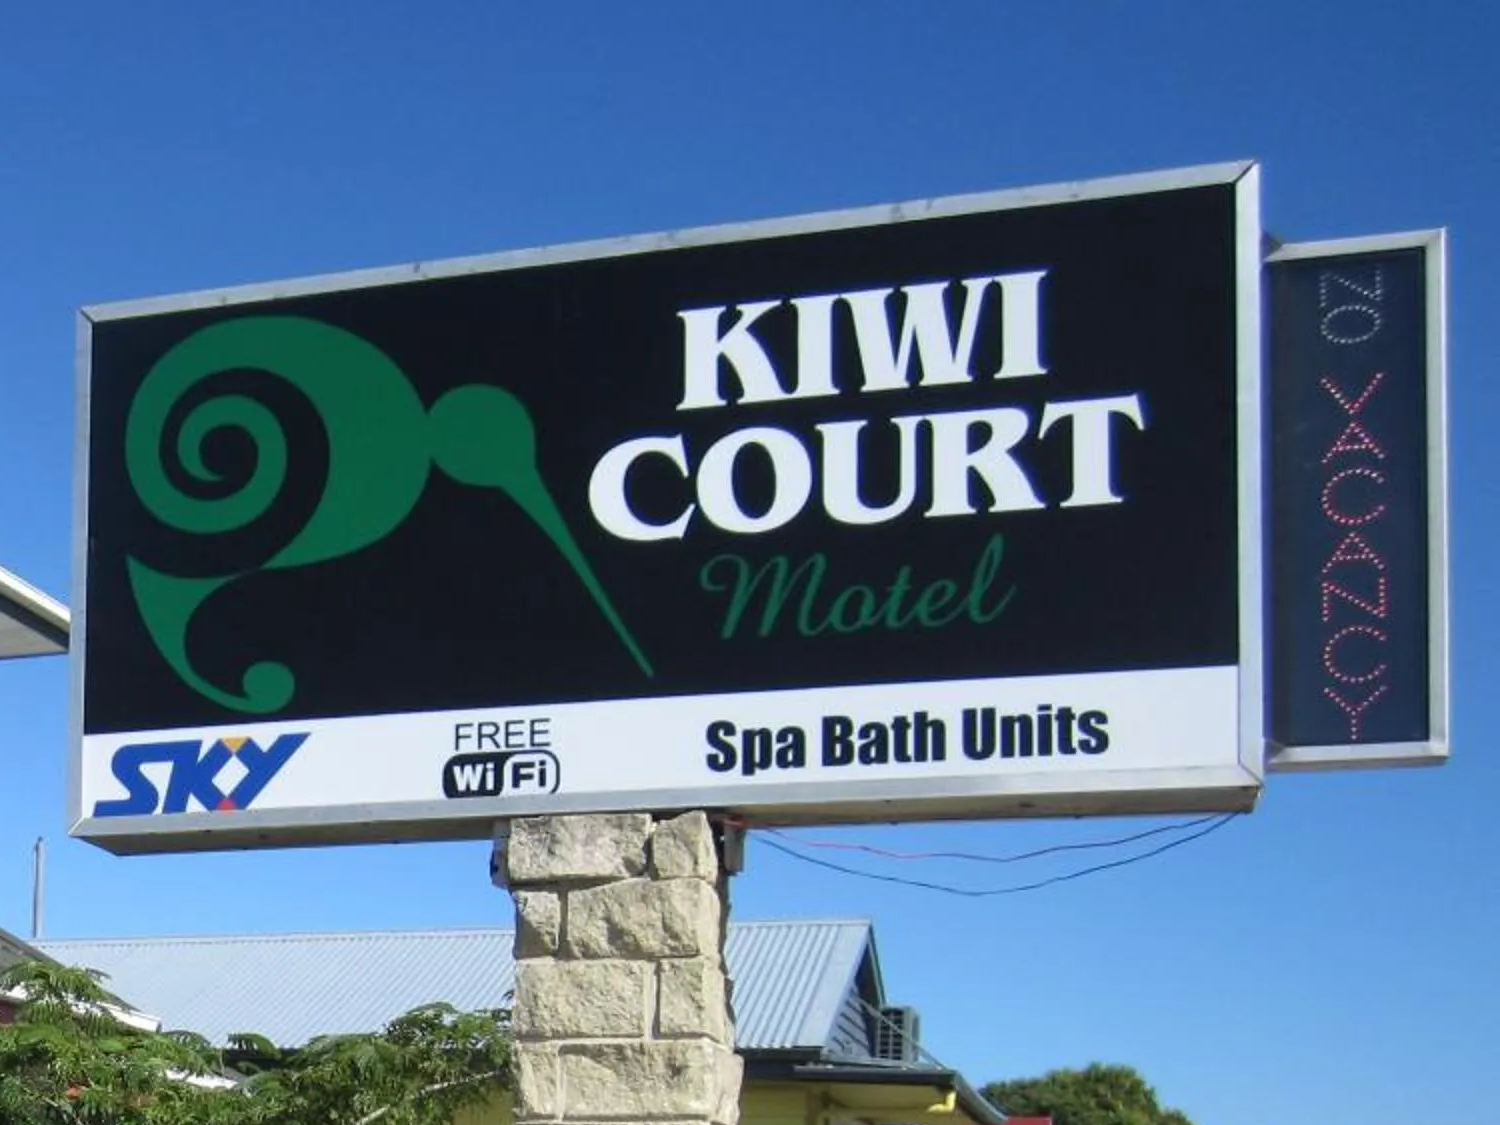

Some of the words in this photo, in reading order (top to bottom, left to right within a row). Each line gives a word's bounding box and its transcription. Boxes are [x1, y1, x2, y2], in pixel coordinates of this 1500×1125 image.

[675, 270, 1049, 410] KIWI
[1319, 266, 1383, 343] NO
[589, 394, 1145, 541] COURT
[699, 533, 1017, 639] Motel
[1320, 371, 1388, 741] VACANCY
[93, 732, 311, 817] SKY
[454, 717, 552, 751] FREE
[706, 720, 806, 776] Spa
[821, 711, 947, 767] Bath
[961, 704, 1110, 760] Units
